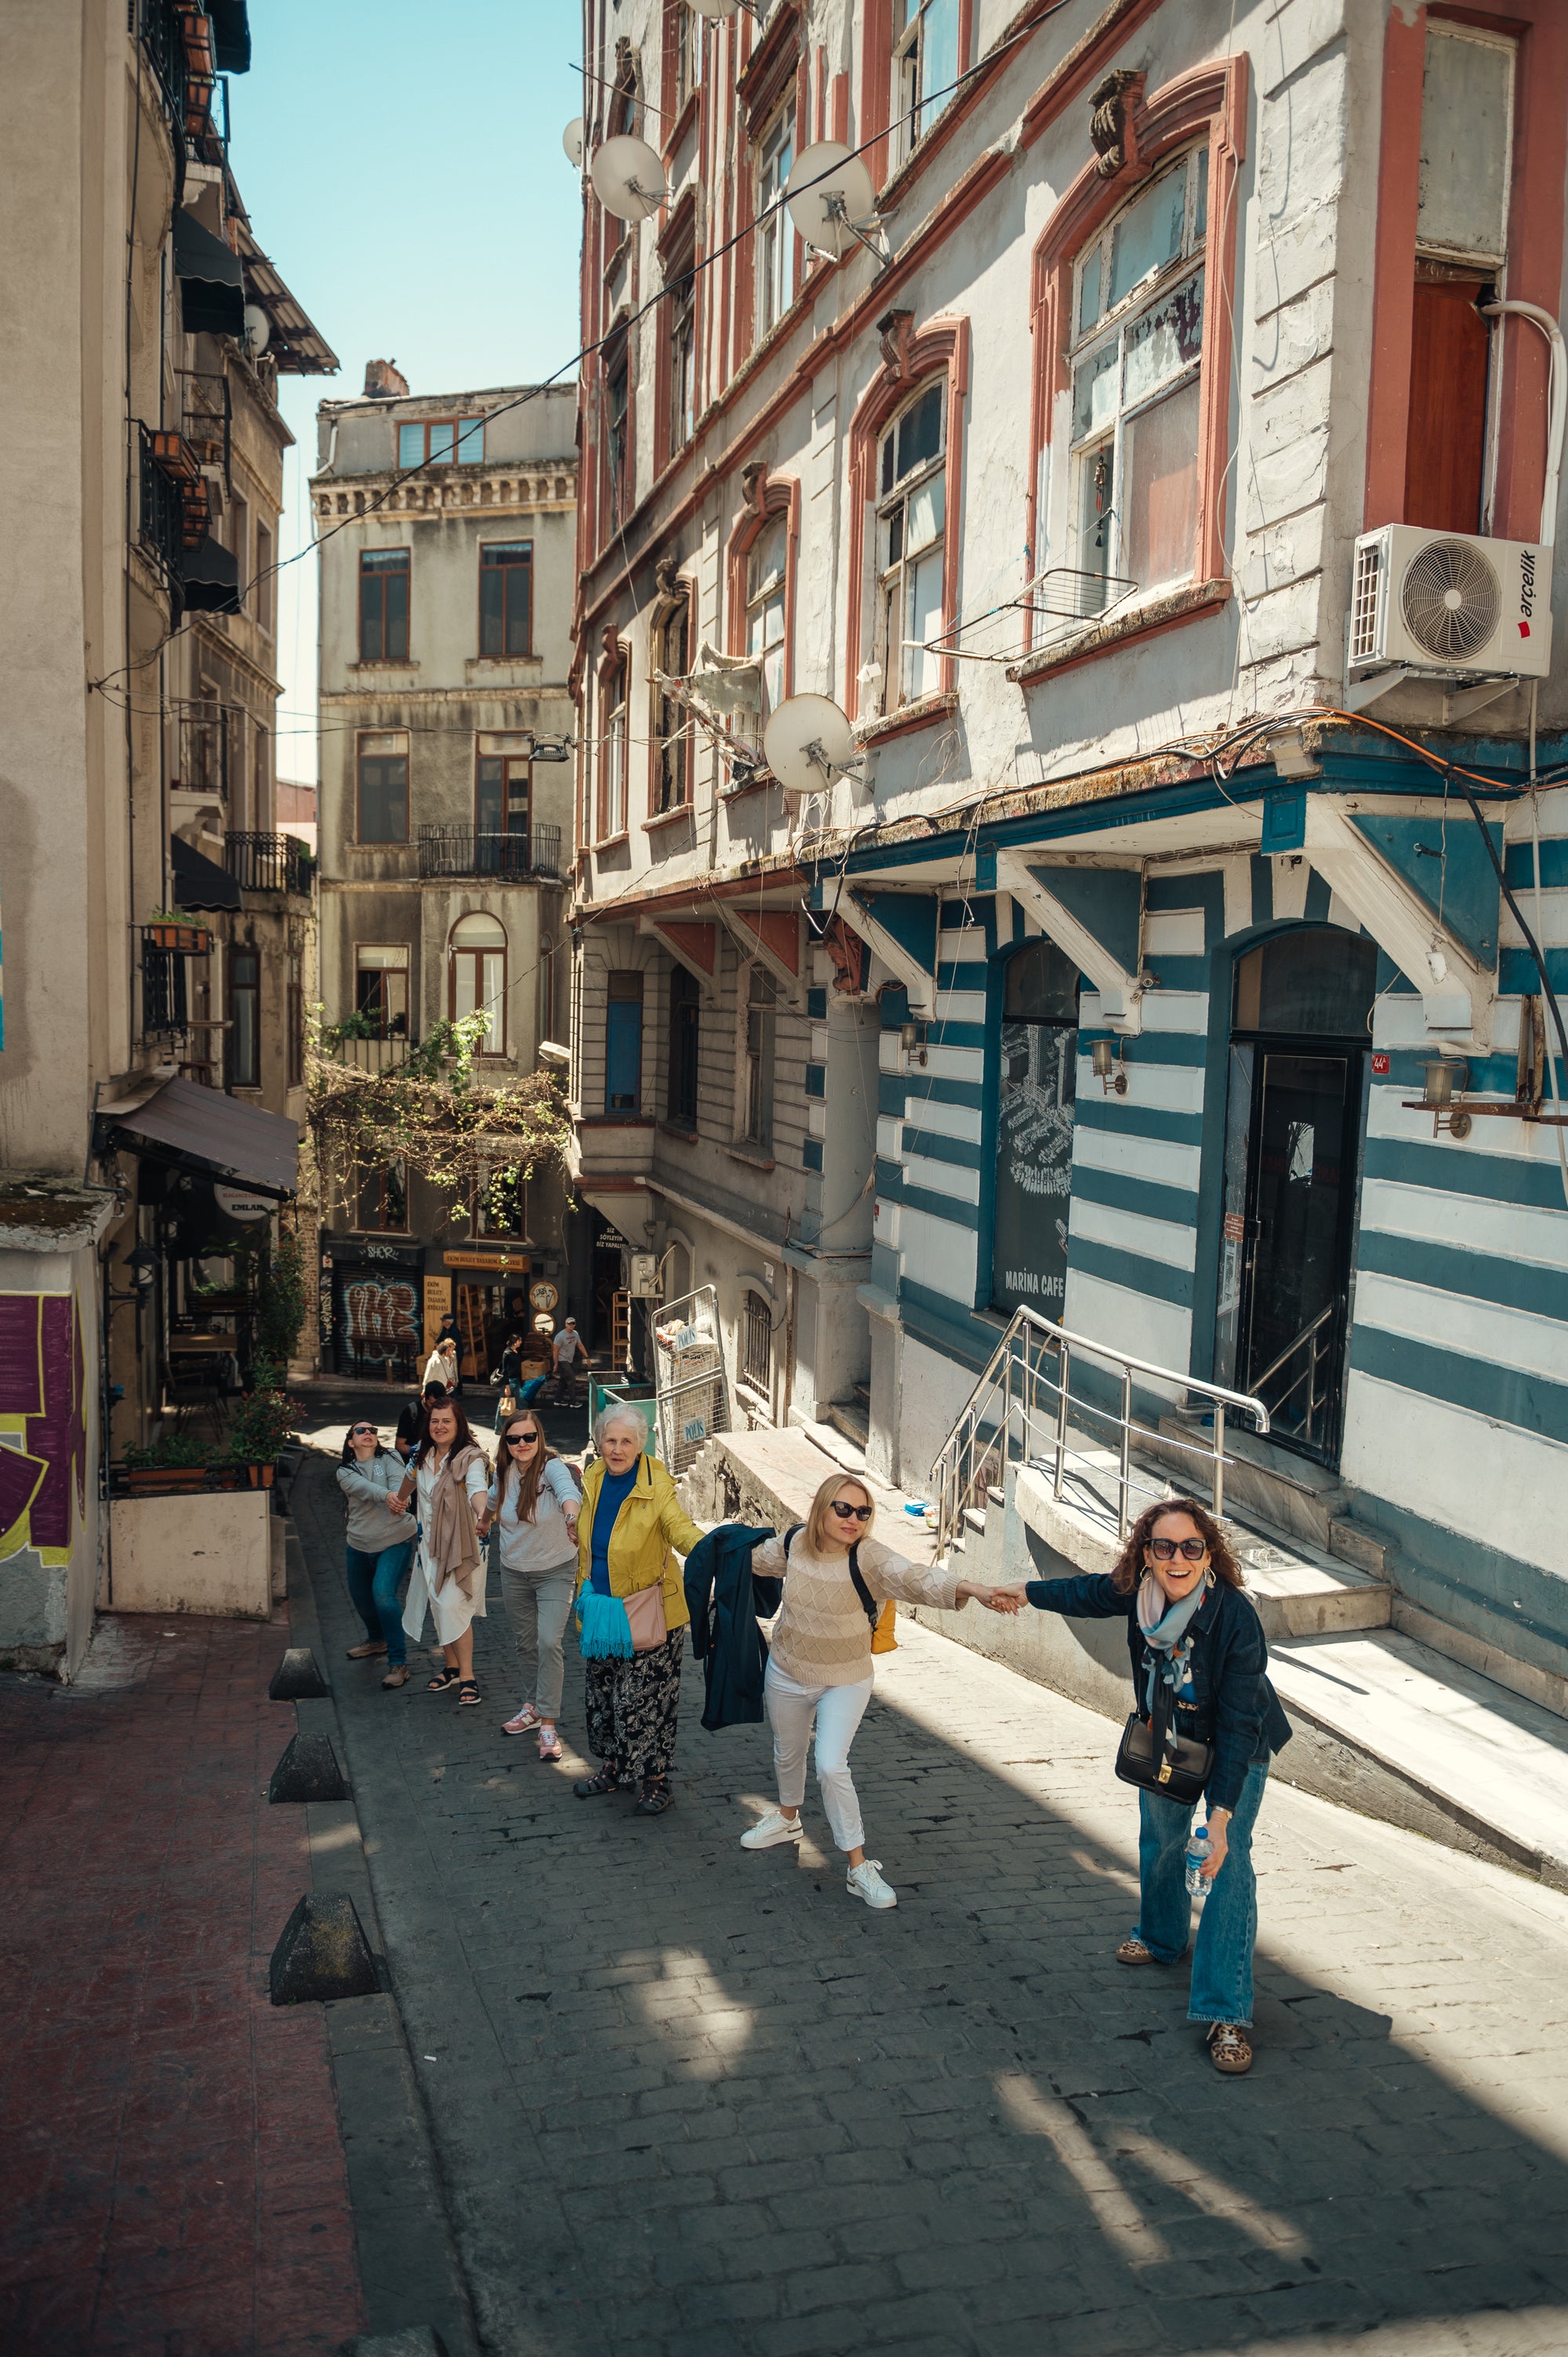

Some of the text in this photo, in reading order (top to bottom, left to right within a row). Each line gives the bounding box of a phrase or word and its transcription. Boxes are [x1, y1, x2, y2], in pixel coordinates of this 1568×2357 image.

[1519, 550, 1536, 618] arçelik
[1041, 1275, 1064, 1298] CAFE
[678, 1326, 696, 1349] POLİS
[684, 1419, 704, 1441] POLİS
